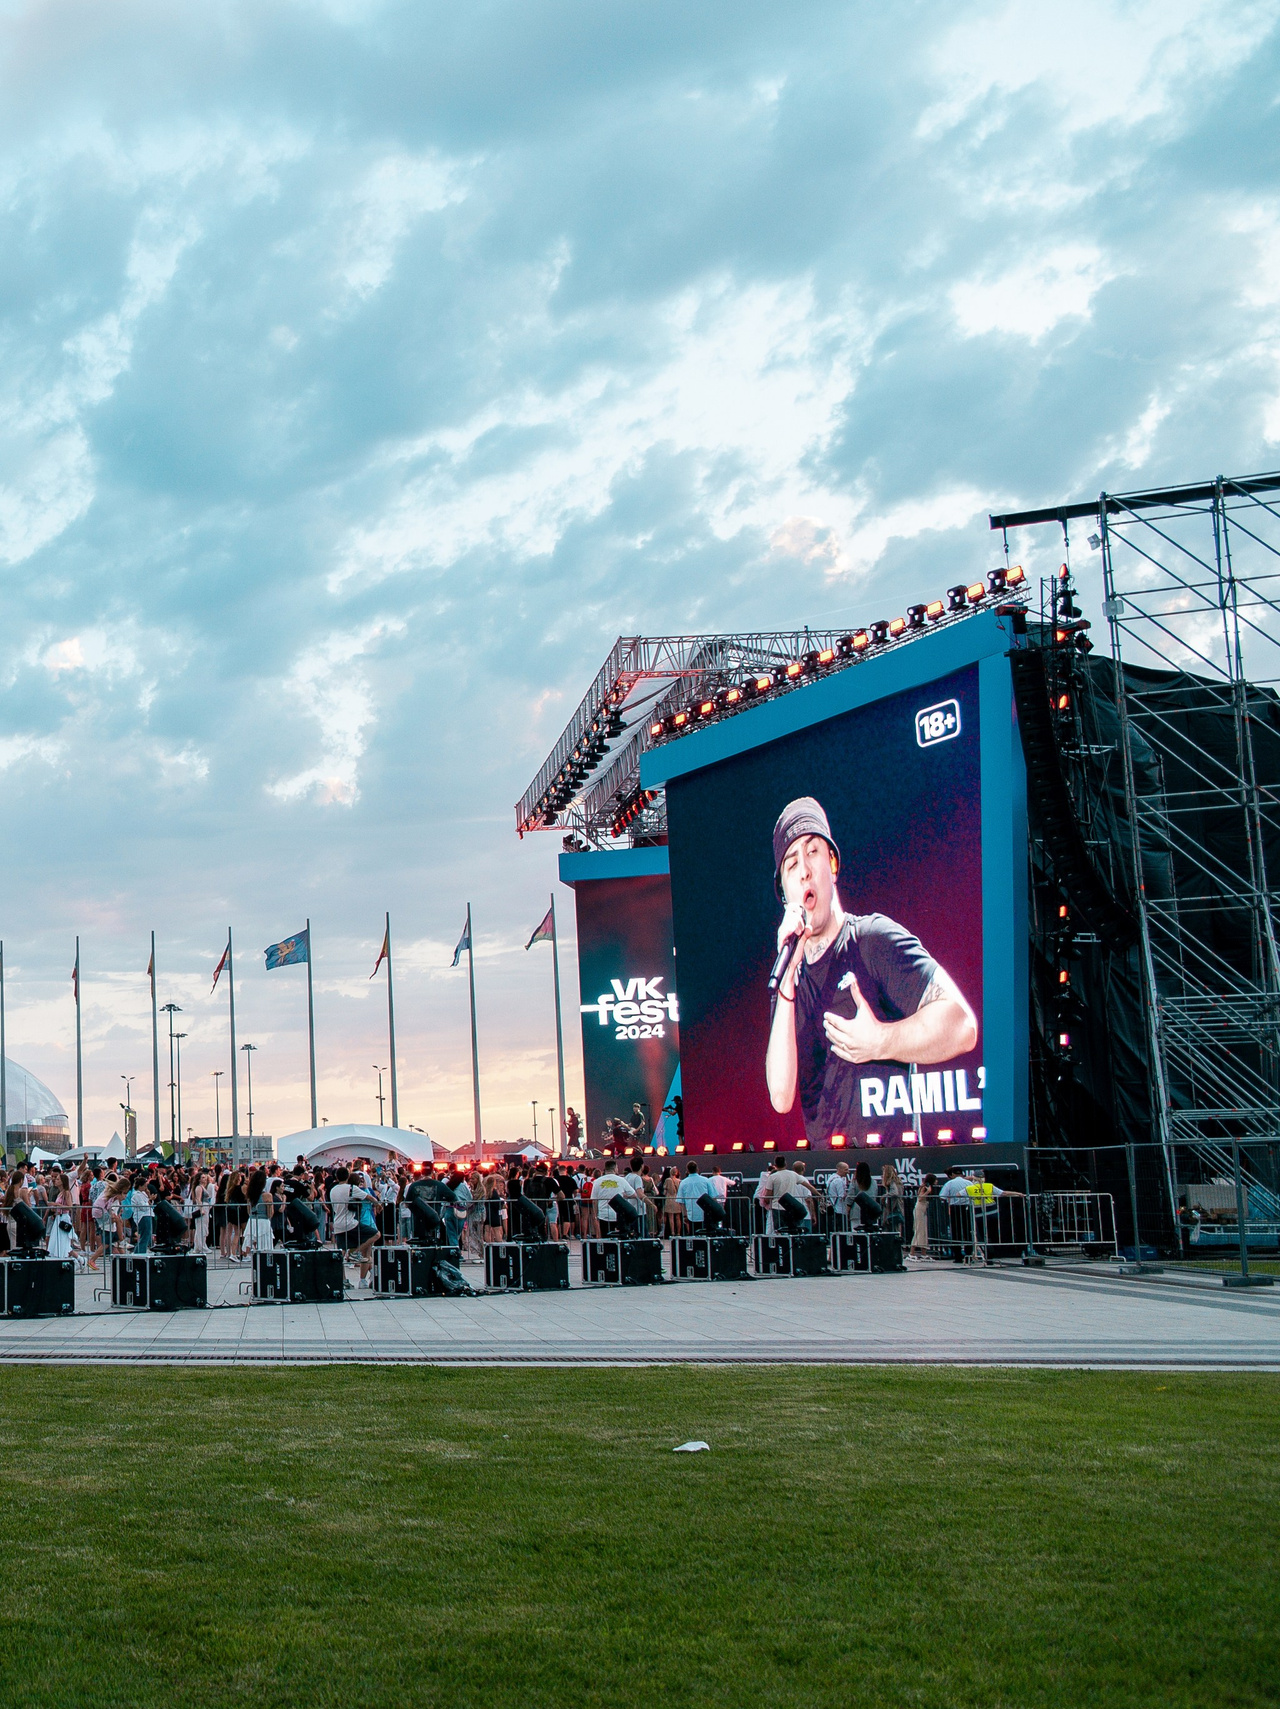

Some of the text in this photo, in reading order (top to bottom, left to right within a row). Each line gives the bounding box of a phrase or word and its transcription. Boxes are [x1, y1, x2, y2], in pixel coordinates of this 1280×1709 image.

[919, 711, 956, 740] 18+
[610, 976, 665, 1001] VK
[597, 992, 680, 1026] fest
[615, 1024, 666, 1040] 2024
[895, 1157, 917, 1173] VK
[897, 1168, 925, 1186] est
